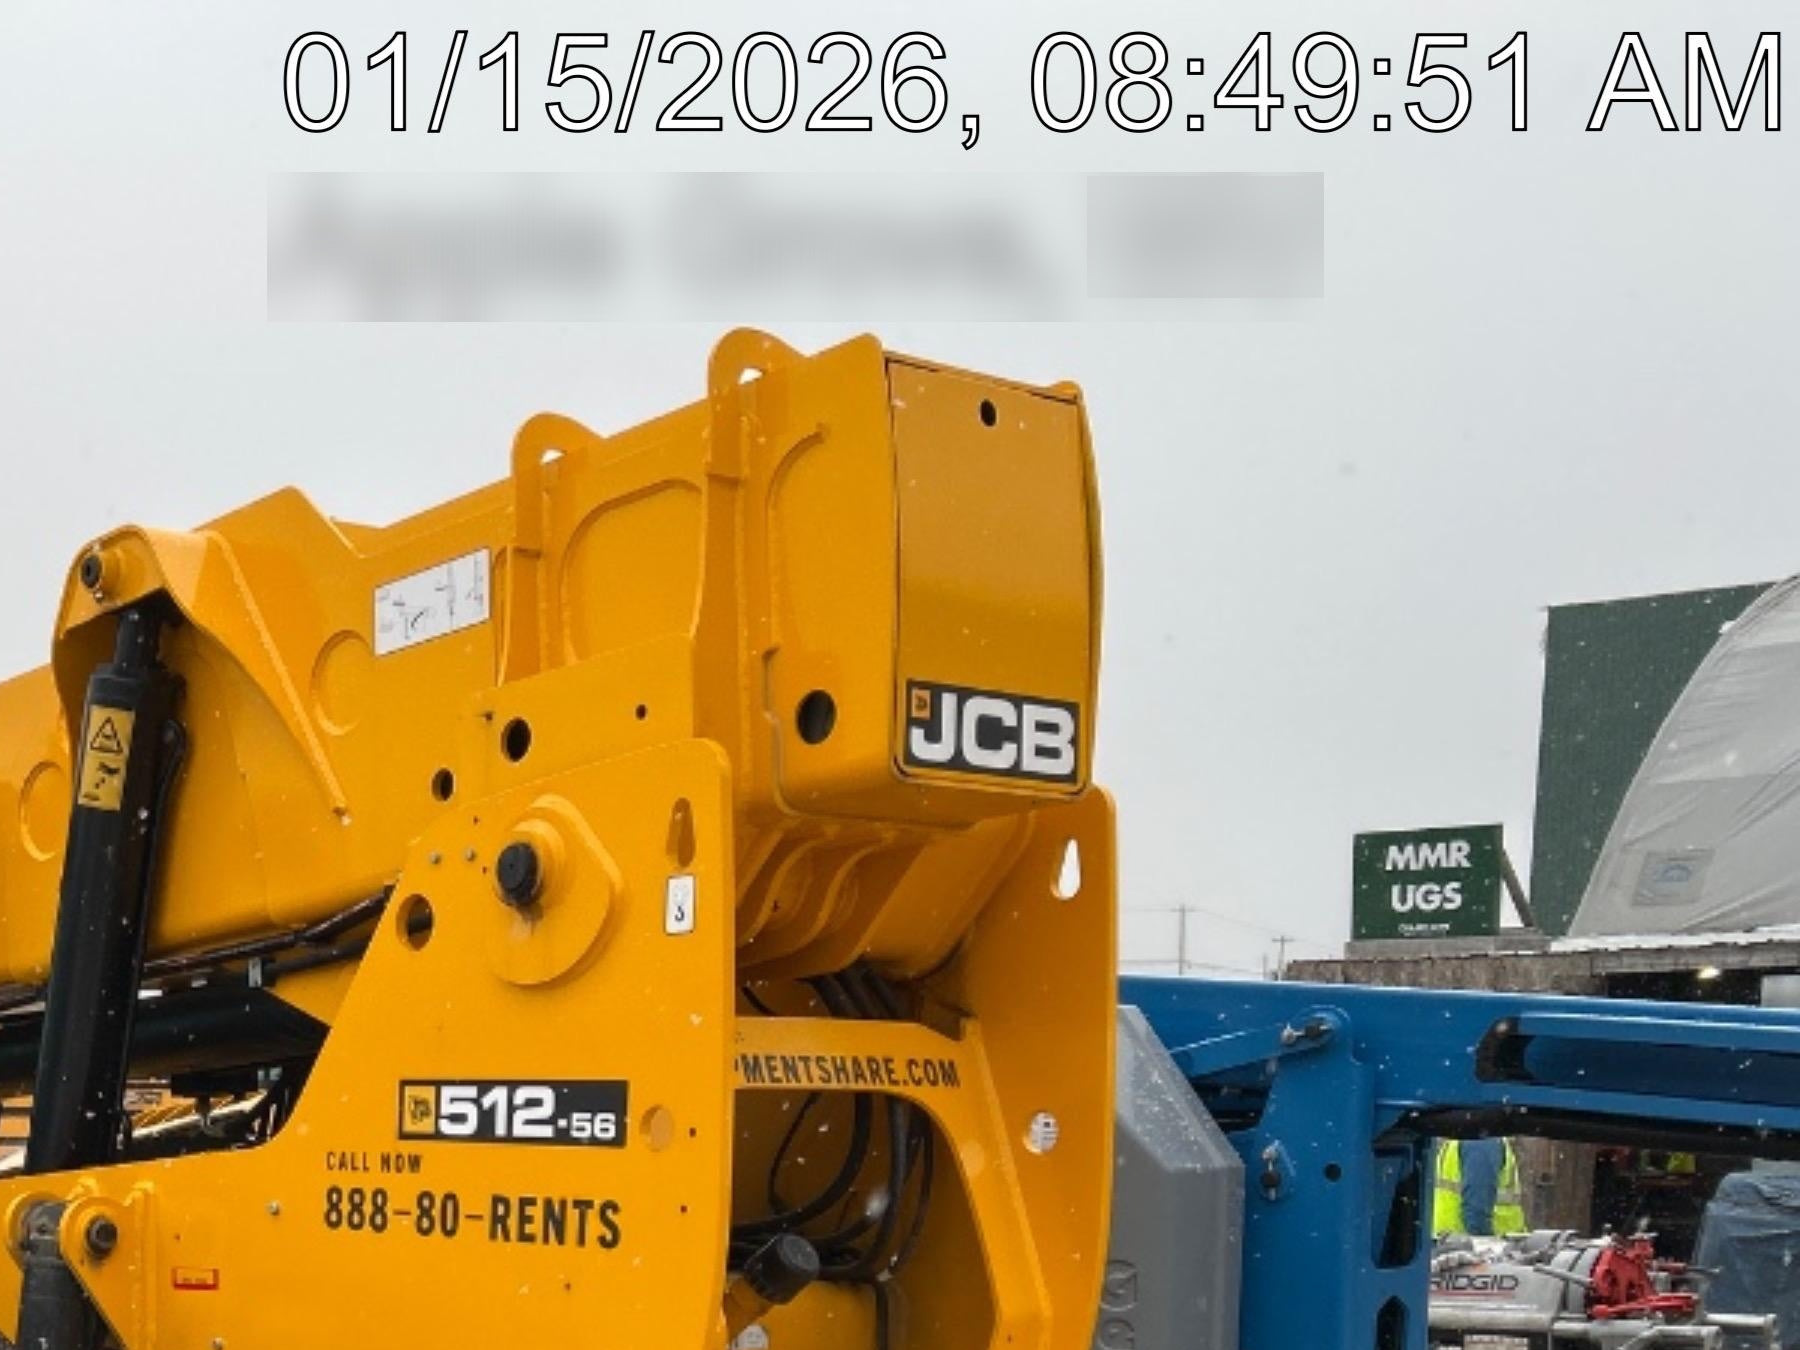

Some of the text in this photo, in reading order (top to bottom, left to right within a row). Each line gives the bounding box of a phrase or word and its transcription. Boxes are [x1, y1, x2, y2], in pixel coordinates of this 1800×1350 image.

[909, 692, 1076, 775] JCB
[1384, 839, 1472, 871] MMR
[1390, 881, 1463, 913] UGS
[733, 1052, 961, 1088] MENTSHARE.COM
[326, 1151, 422, 1173] CALL NOW
[324, 1186, 621, 1249] 888-80-RENTS
